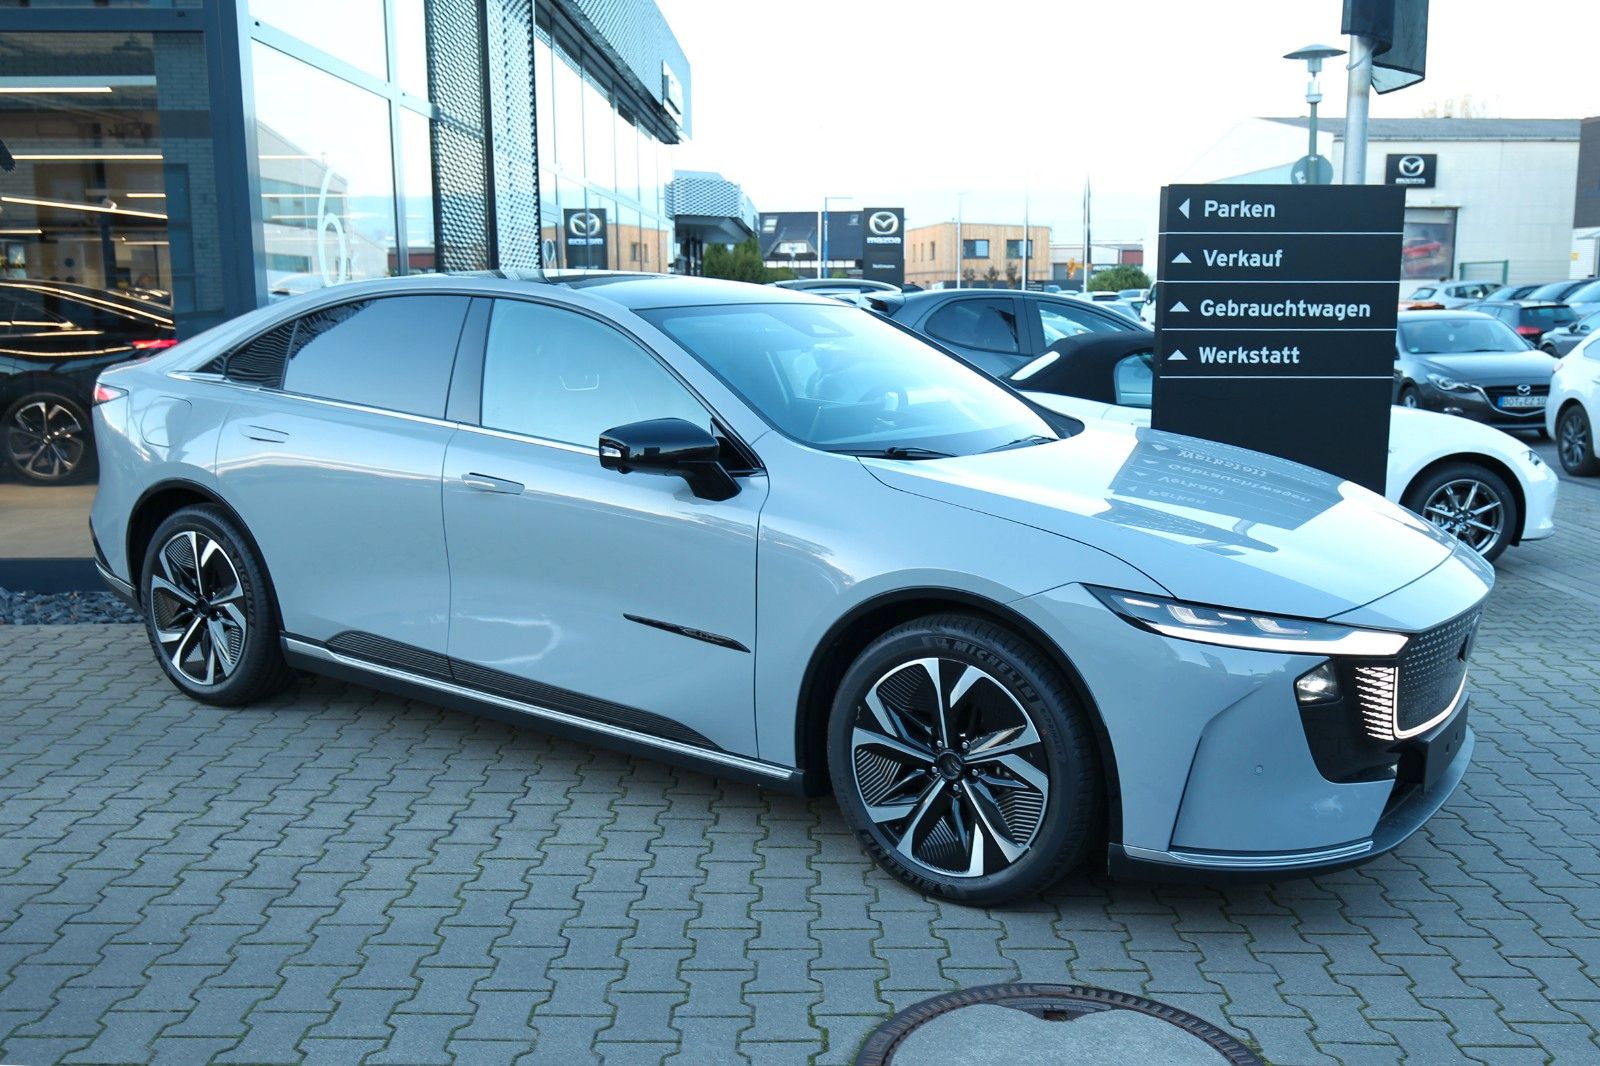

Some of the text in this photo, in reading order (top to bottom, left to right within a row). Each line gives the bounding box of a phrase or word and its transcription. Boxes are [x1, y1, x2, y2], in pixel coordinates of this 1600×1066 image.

[1204, 200, 1275, 217] Parken
[1203, 249, 1283, 267] Verkauf
[1200, 299, 1370, 321] Gebrauchtwagen
[1199, 347, 1300, 363] Werkstatt
[953, 641, 1037, 701] MICHELIN
